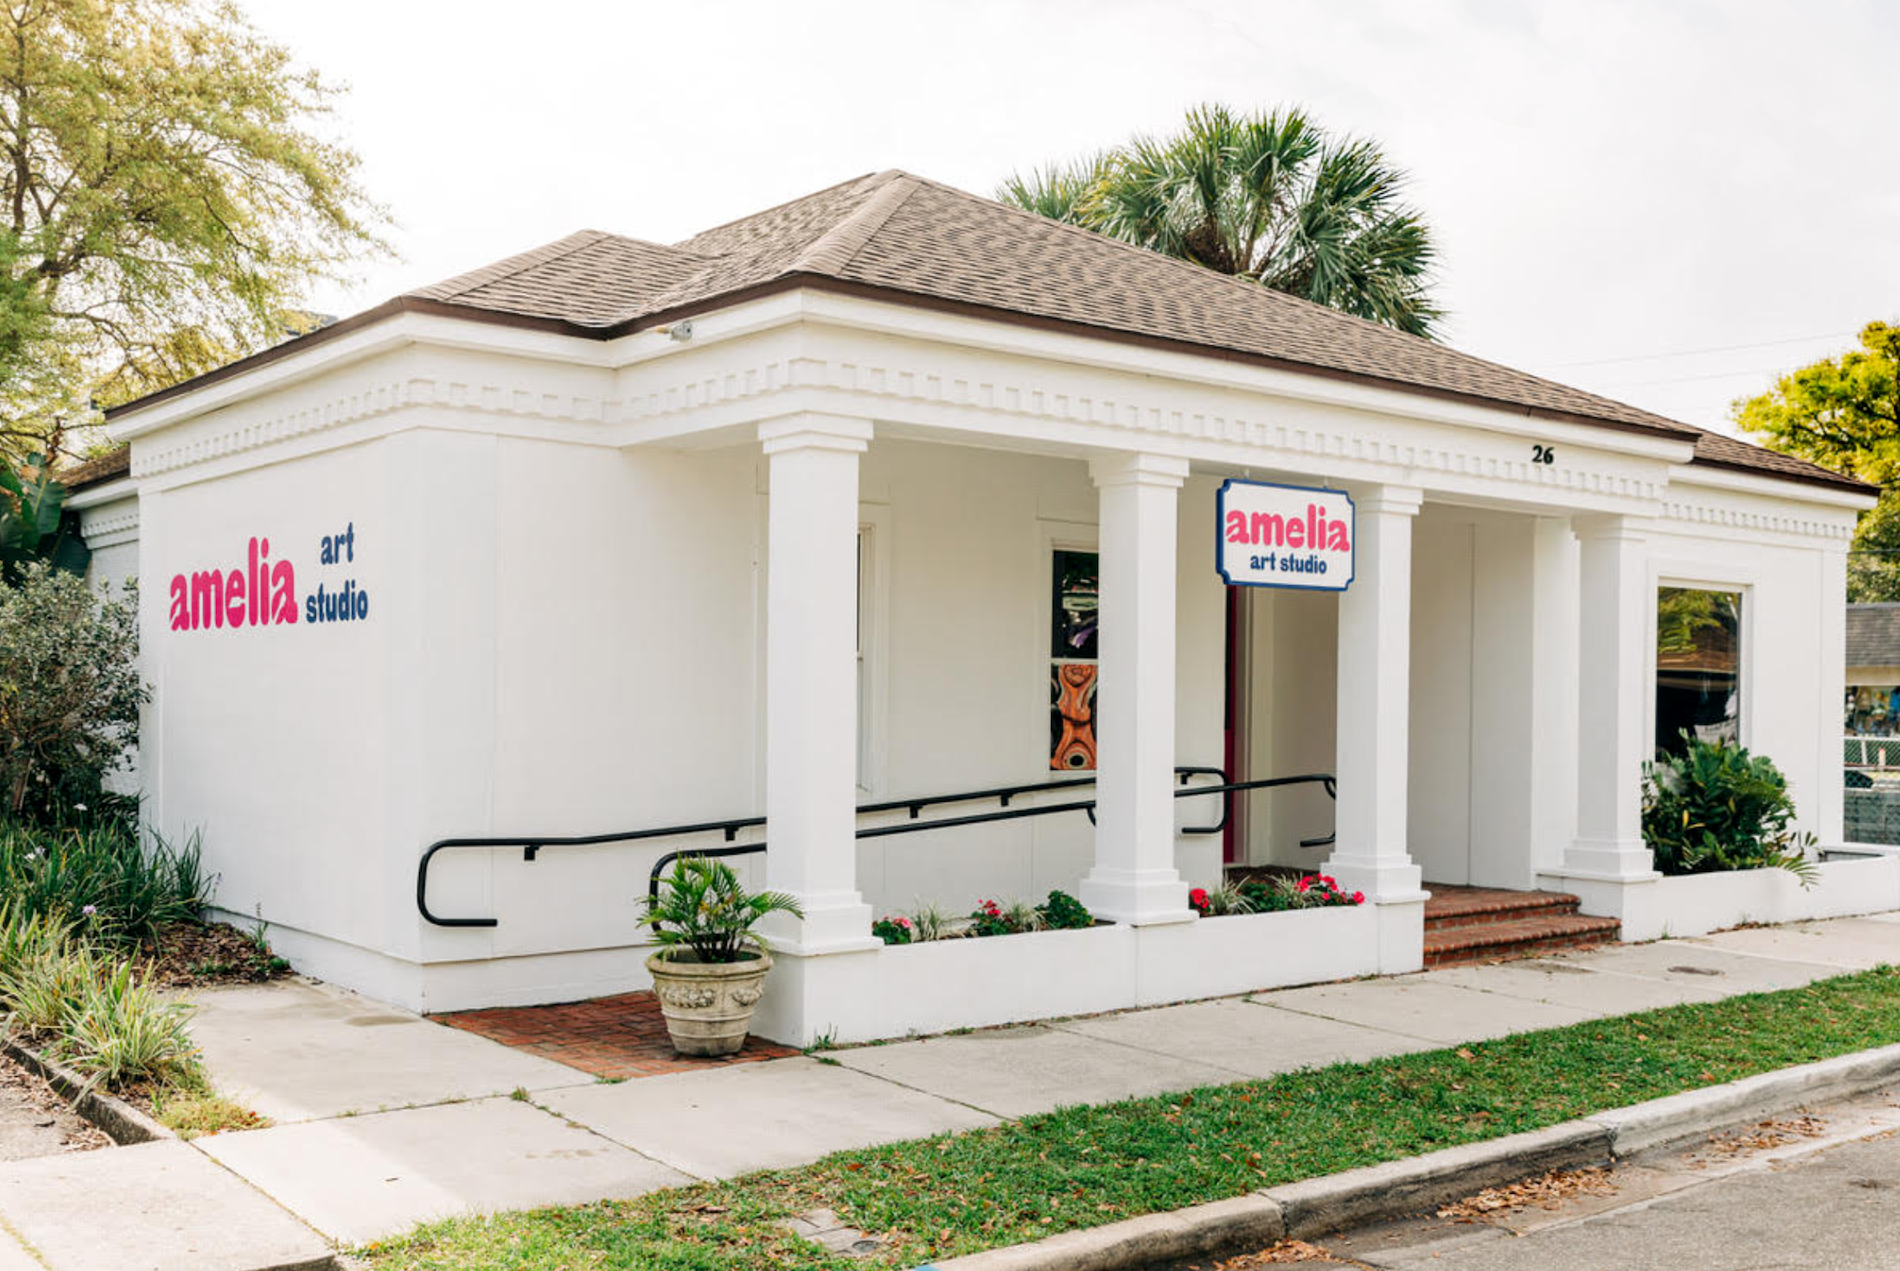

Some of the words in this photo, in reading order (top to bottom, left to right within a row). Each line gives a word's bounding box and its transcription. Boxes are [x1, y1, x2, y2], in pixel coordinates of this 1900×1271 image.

[1532, 445, 1554, 465] 26
[320, 522, 354, 565] art
[1226, 503, 1350, 552] amelia
[169, 537, 298, 631] amelia
[1250, 552, 1276, 571] art
[1280, 553, 1327, 574] studio
[306, 579, 368, 623] studio
